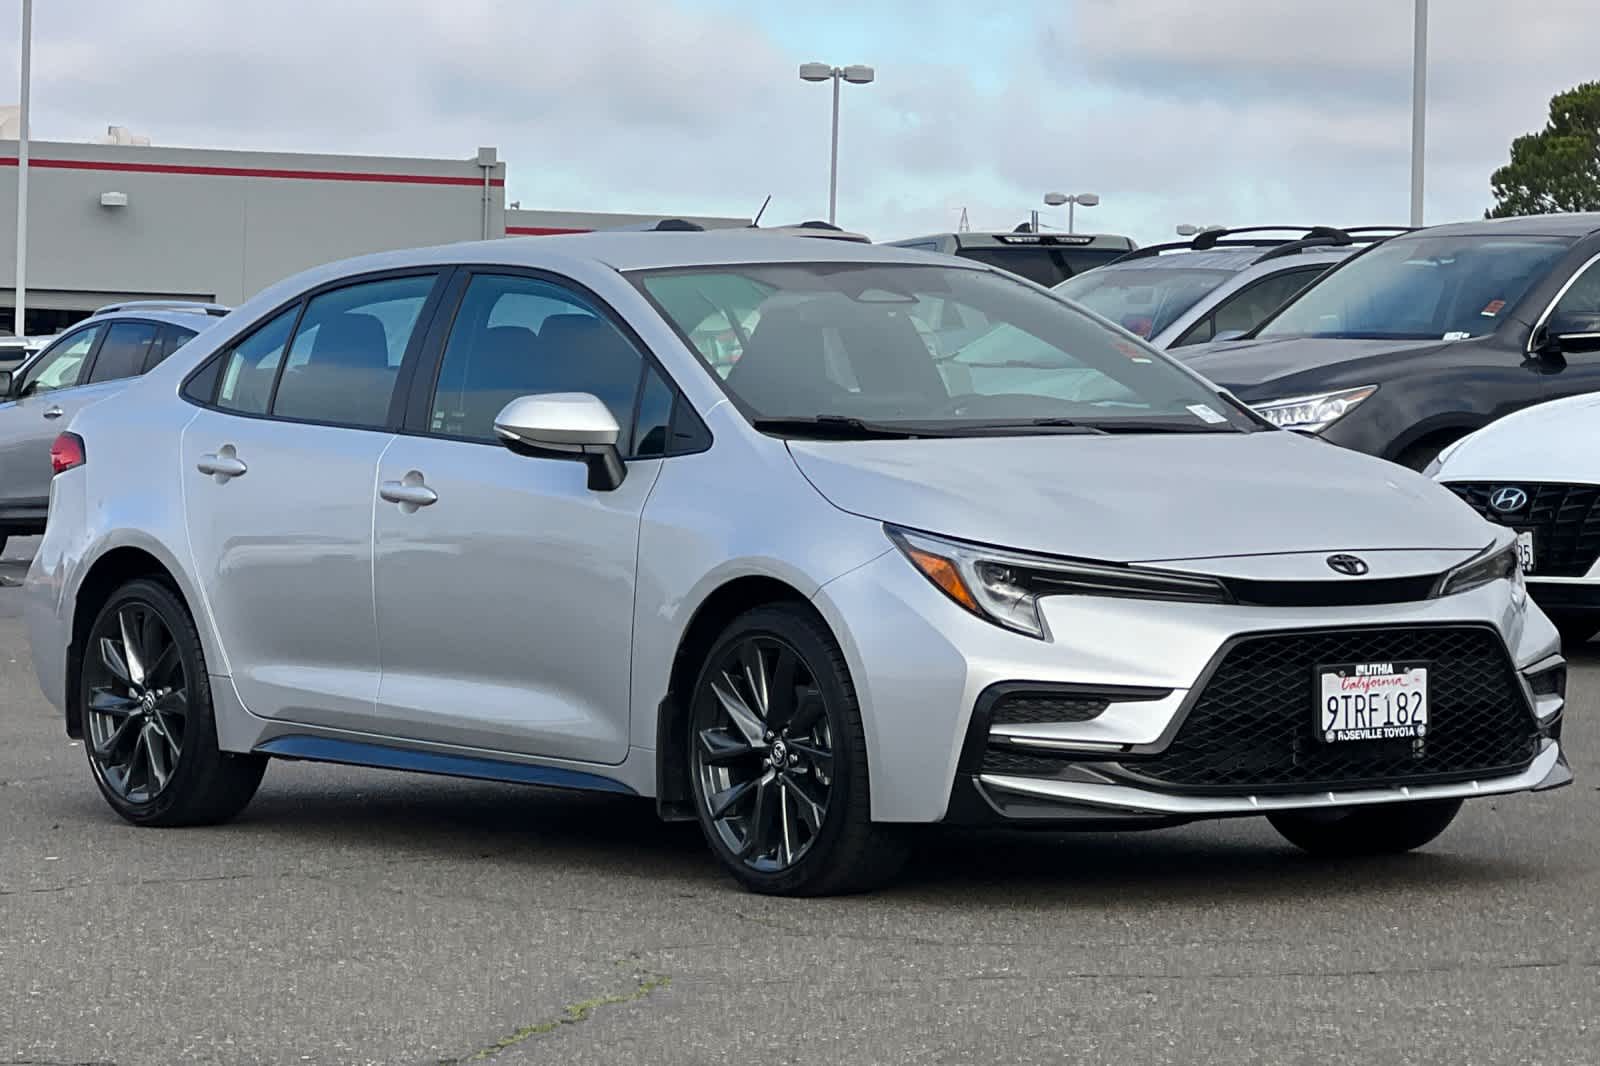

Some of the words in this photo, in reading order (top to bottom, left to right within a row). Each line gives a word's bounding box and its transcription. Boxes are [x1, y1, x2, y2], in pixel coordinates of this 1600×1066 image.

[1363, 663, 1394, 675] LITHIA
[1341, 676, 1408, 694] California
[1327, 691, 1422, 731] 9TRF182
[1337, 729, 1383, 741] ROSEVILLE
[1383, 726, 1415, 738] TOYOTA
